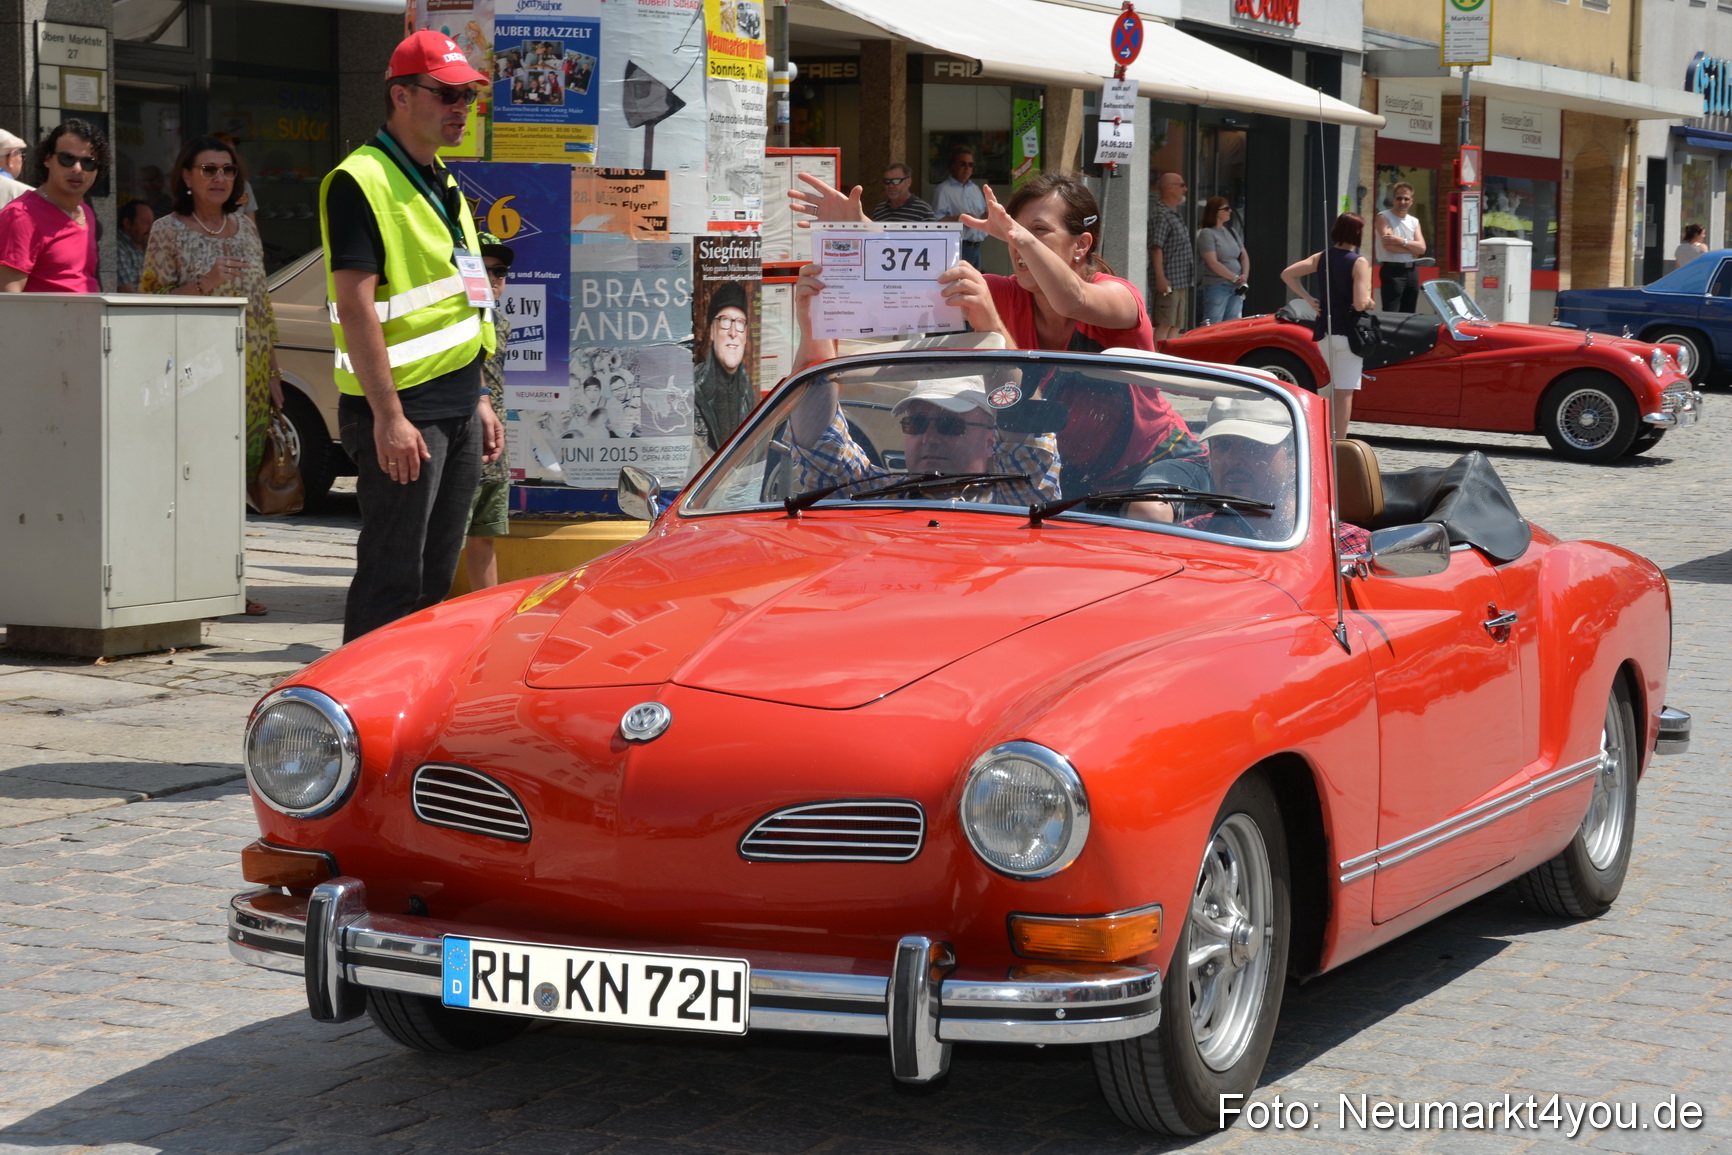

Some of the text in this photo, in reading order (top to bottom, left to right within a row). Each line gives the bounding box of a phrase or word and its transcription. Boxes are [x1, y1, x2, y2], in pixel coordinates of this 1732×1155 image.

[42, 31, 105, 47] Obere Marktstr.
[494, 26, 592, 38] AUBER BRAZZELT
[67, 49, 79, 59] 27
[1410, 118, 1433, 131] CENTRUM
[881, 248, 930, 271] 374
[534, 271, 561, 279] Kultur
[582, 278, 689, 307] BRASS
[505, 297, 541, 317] & Ivy
[523, 326, 542, 338] Air
[572, 311, 673, 340] ANDA
[507, 350, 543, 361] 19 Uhr
[600, 447, 638, 461] 2015
[452, 979, 463, 994] D
[472, 949, 741, 1023] RH KN 72H
